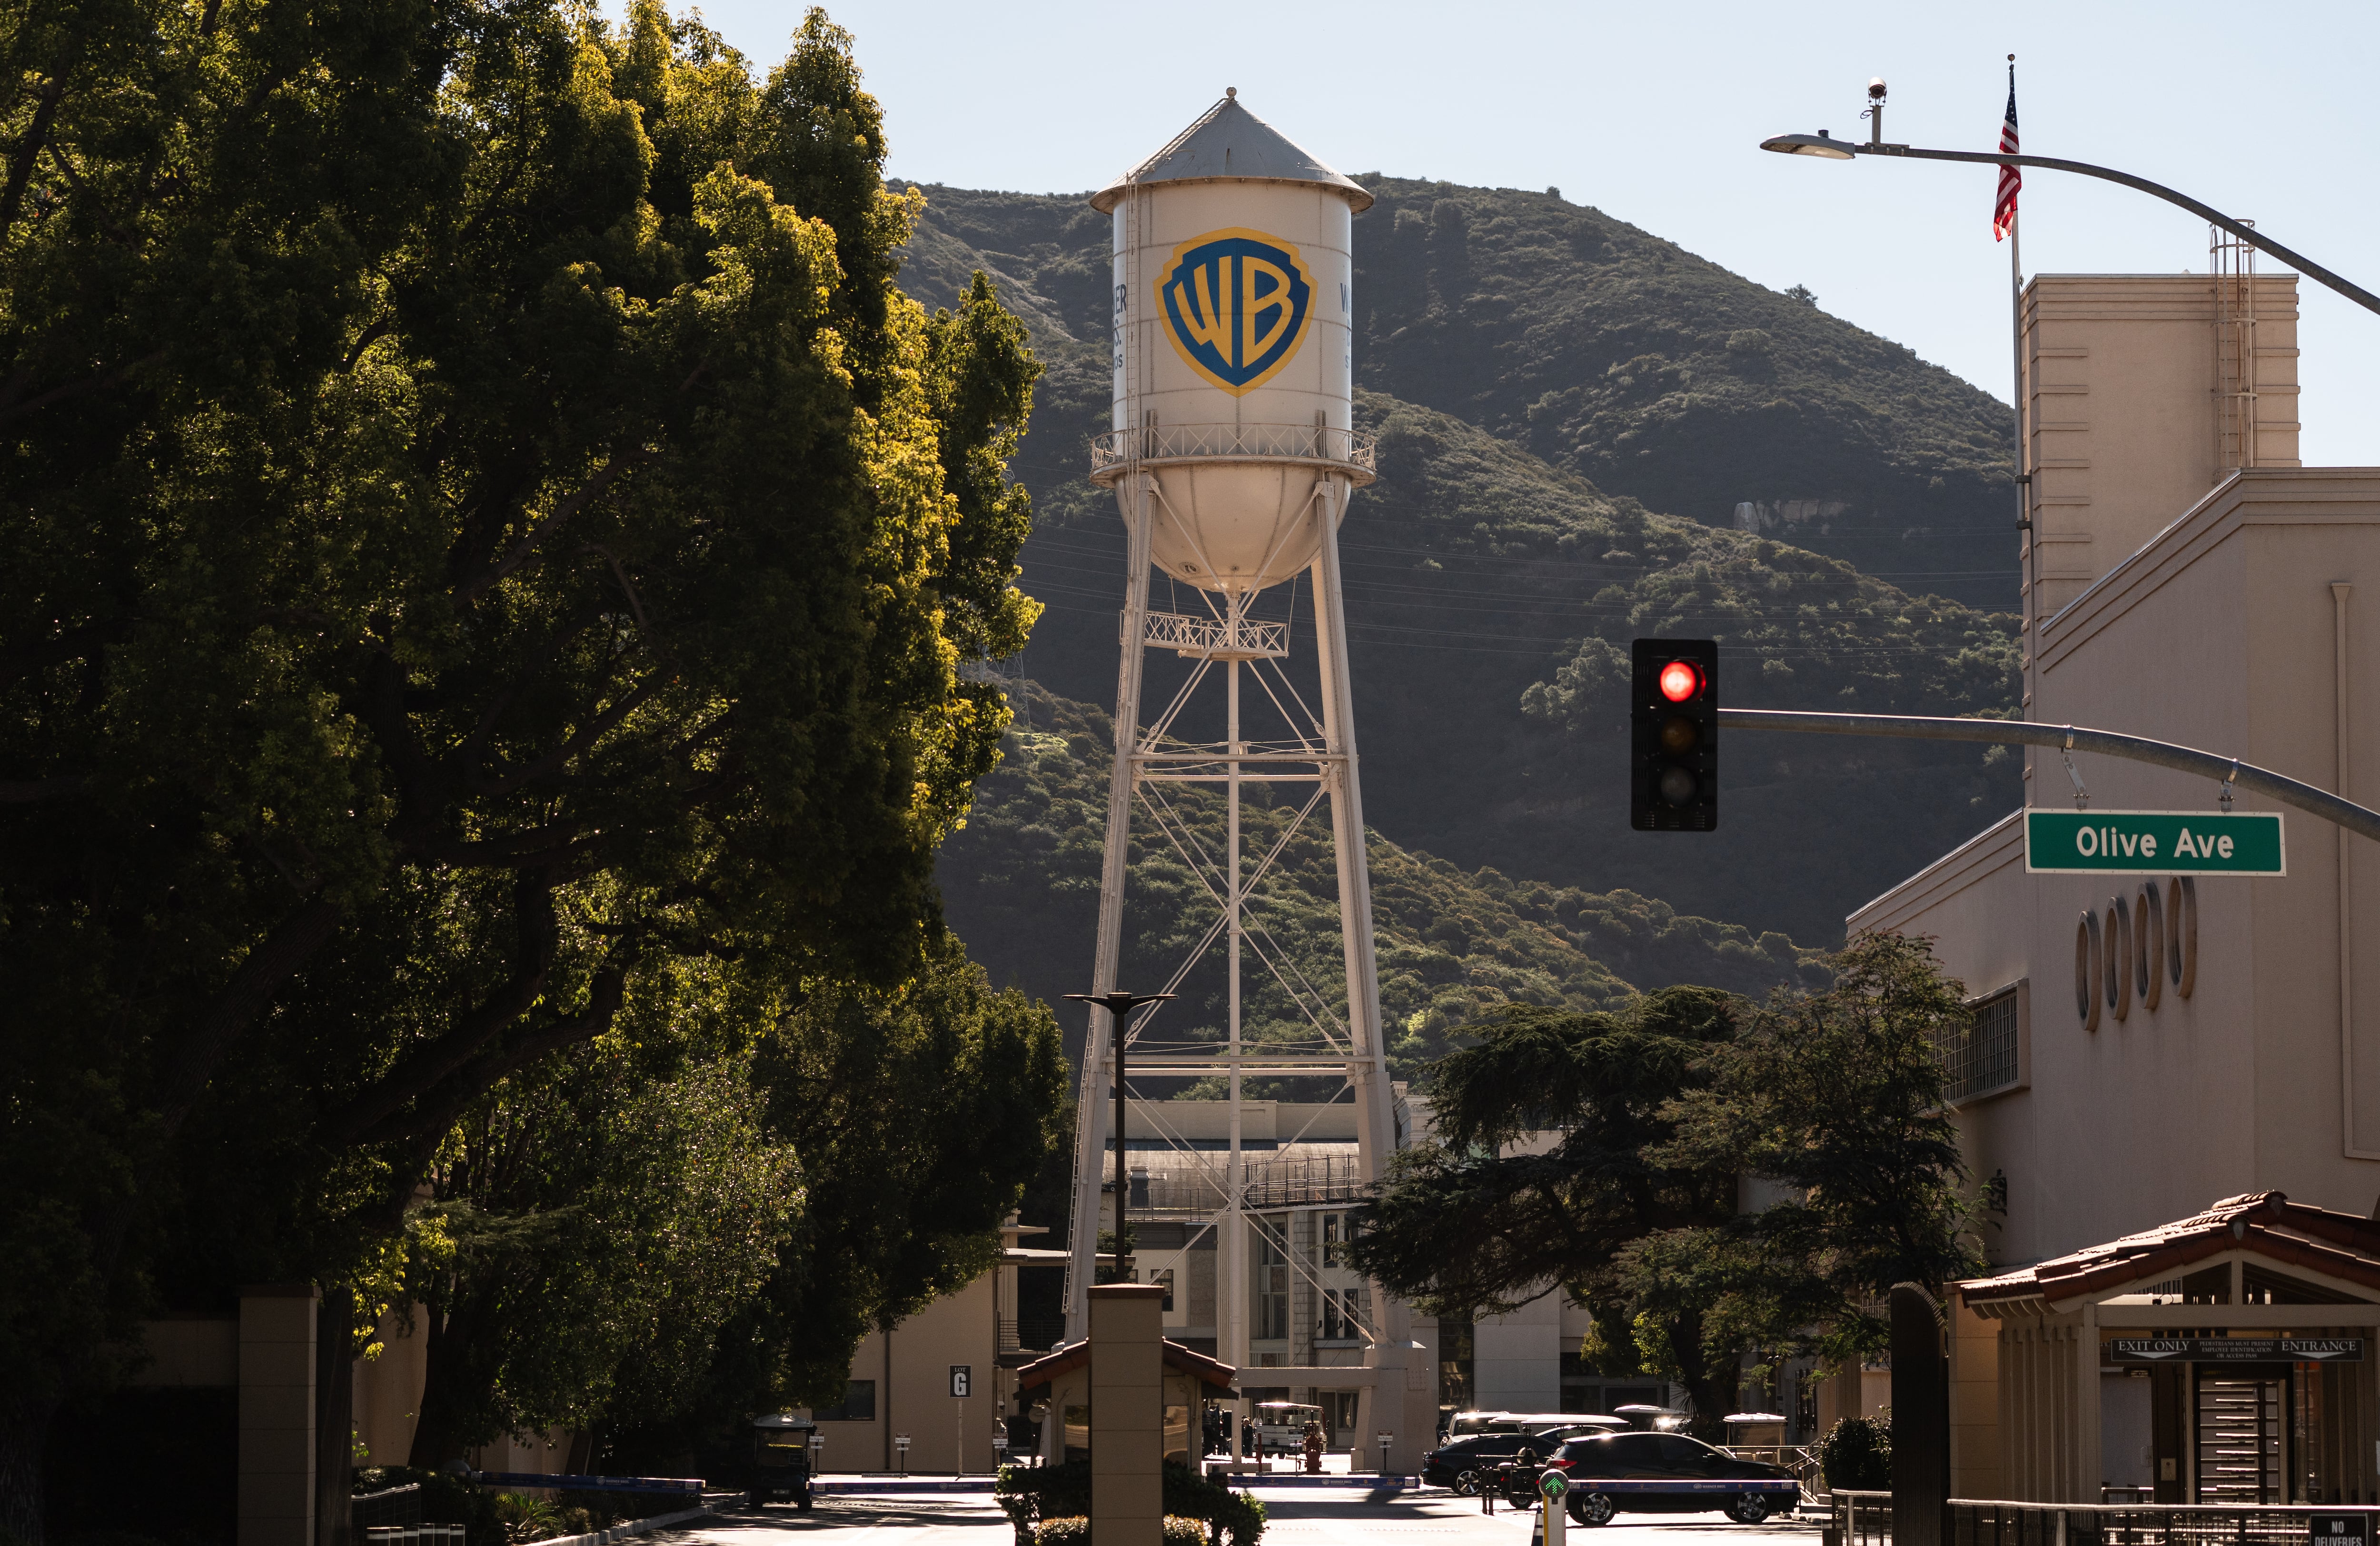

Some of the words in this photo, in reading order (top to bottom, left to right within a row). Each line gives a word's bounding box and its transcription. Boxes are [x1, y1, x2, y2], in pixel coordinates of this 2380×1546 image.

[1173, 256, 1294, 368] WB
[2076, 826, 2157, 858] Olive
[2173, 828, 2234, 858] Ave
[2118, 1341, 2150, 1351] EXIT
[2155, 1341, 2190, 1351] ONLY
[2281, 1340, 2356, 1351] ENTRANCE
[954, 1373, 966, 1396] G
[2331, 1521, 2344, 1534] NO
[2315, 1536, 2362, 1546] DELIVERIES
